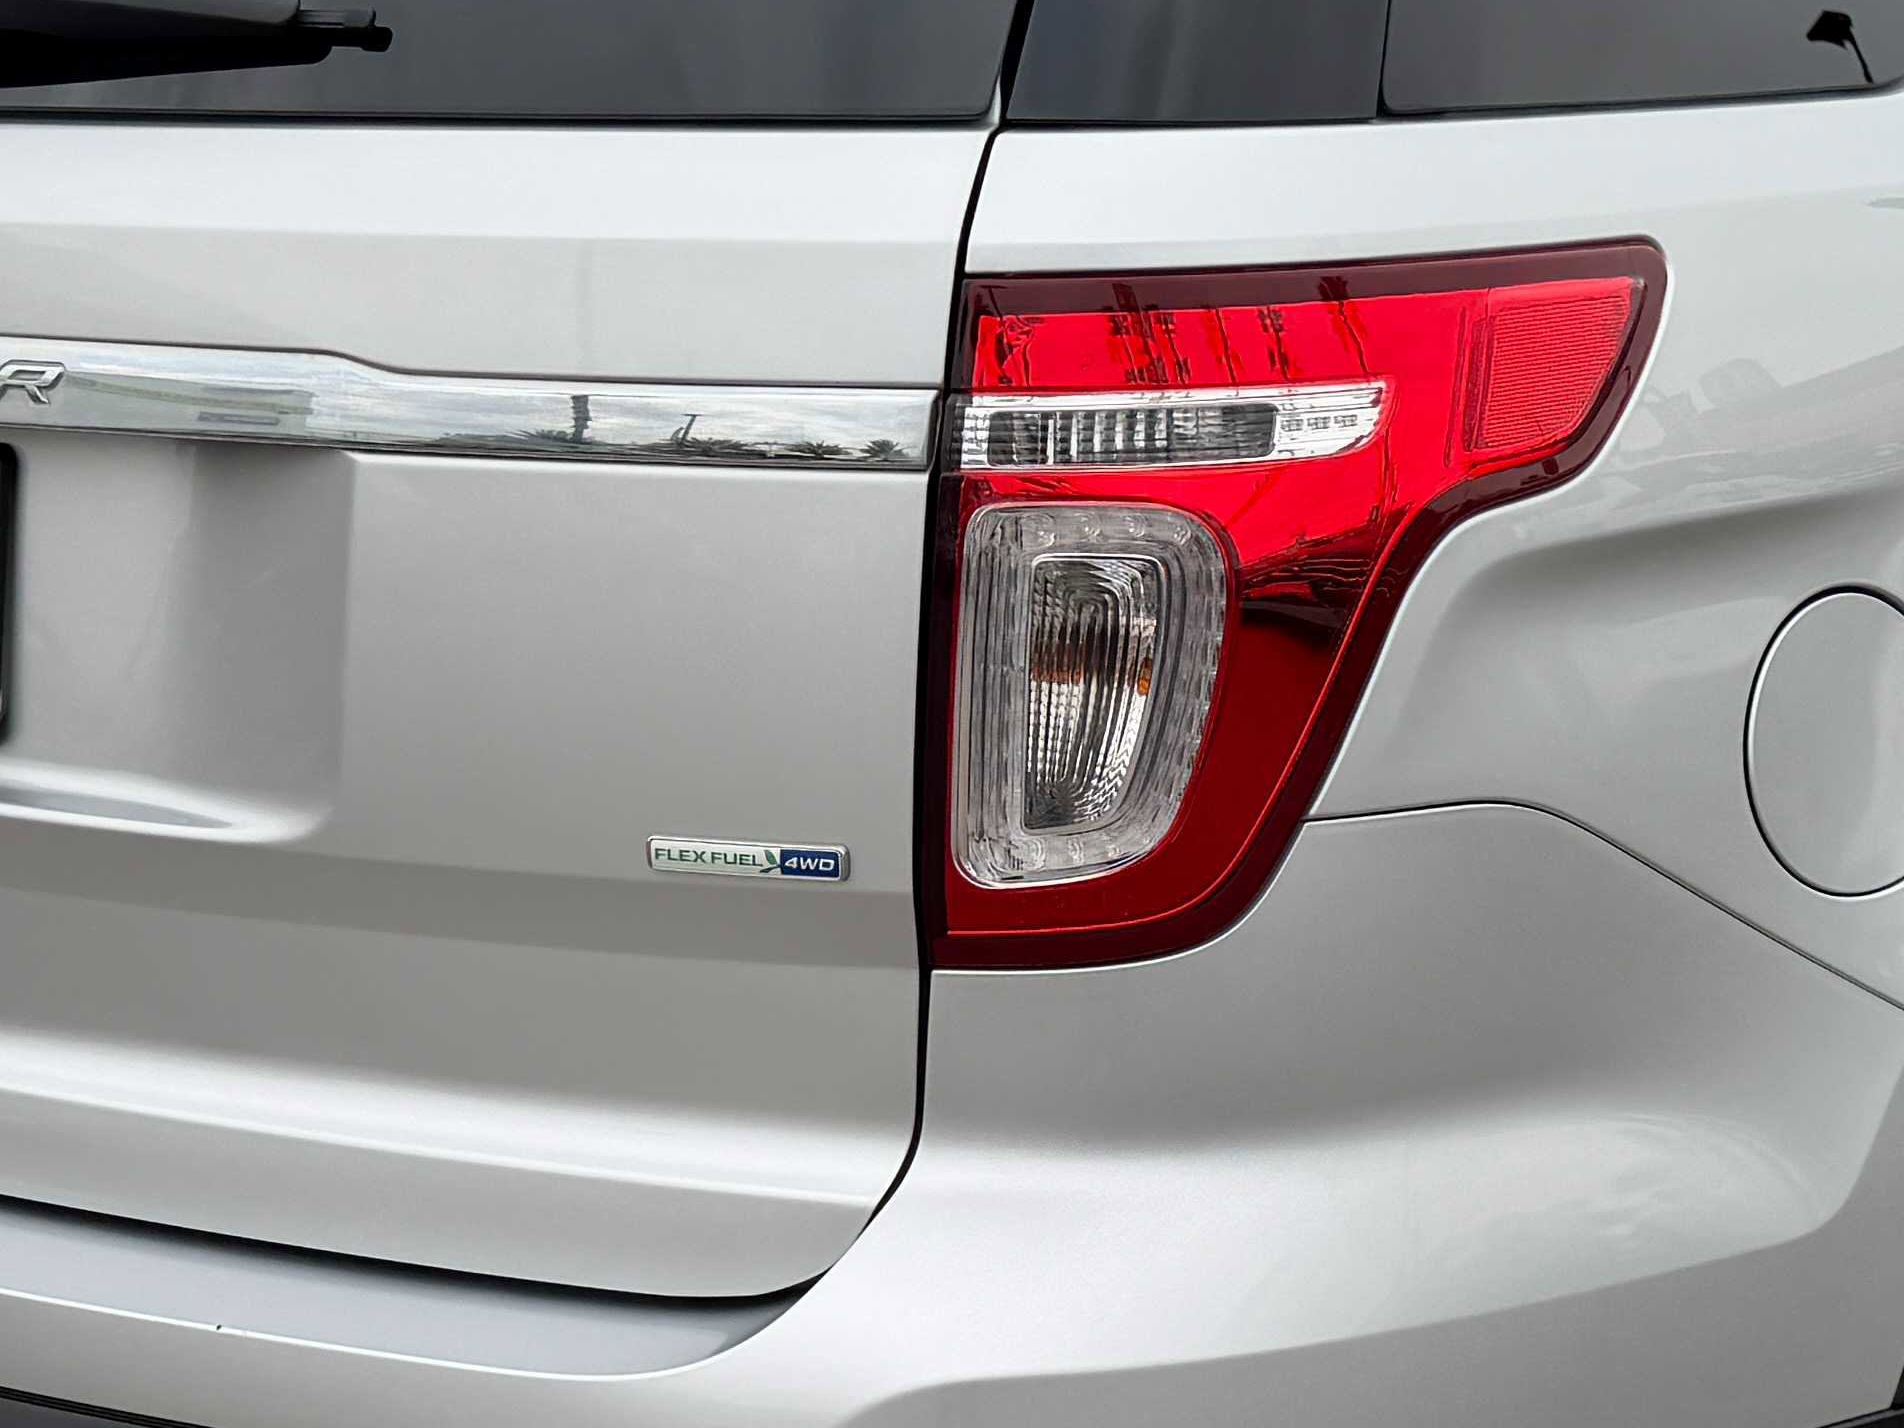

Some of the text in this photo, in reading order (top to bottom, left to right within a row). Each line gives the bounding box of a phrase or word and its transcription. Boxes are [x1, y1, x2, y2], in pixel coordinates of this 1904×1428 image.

[654, 847, 835, 871] FLEX FUEL 4WD
